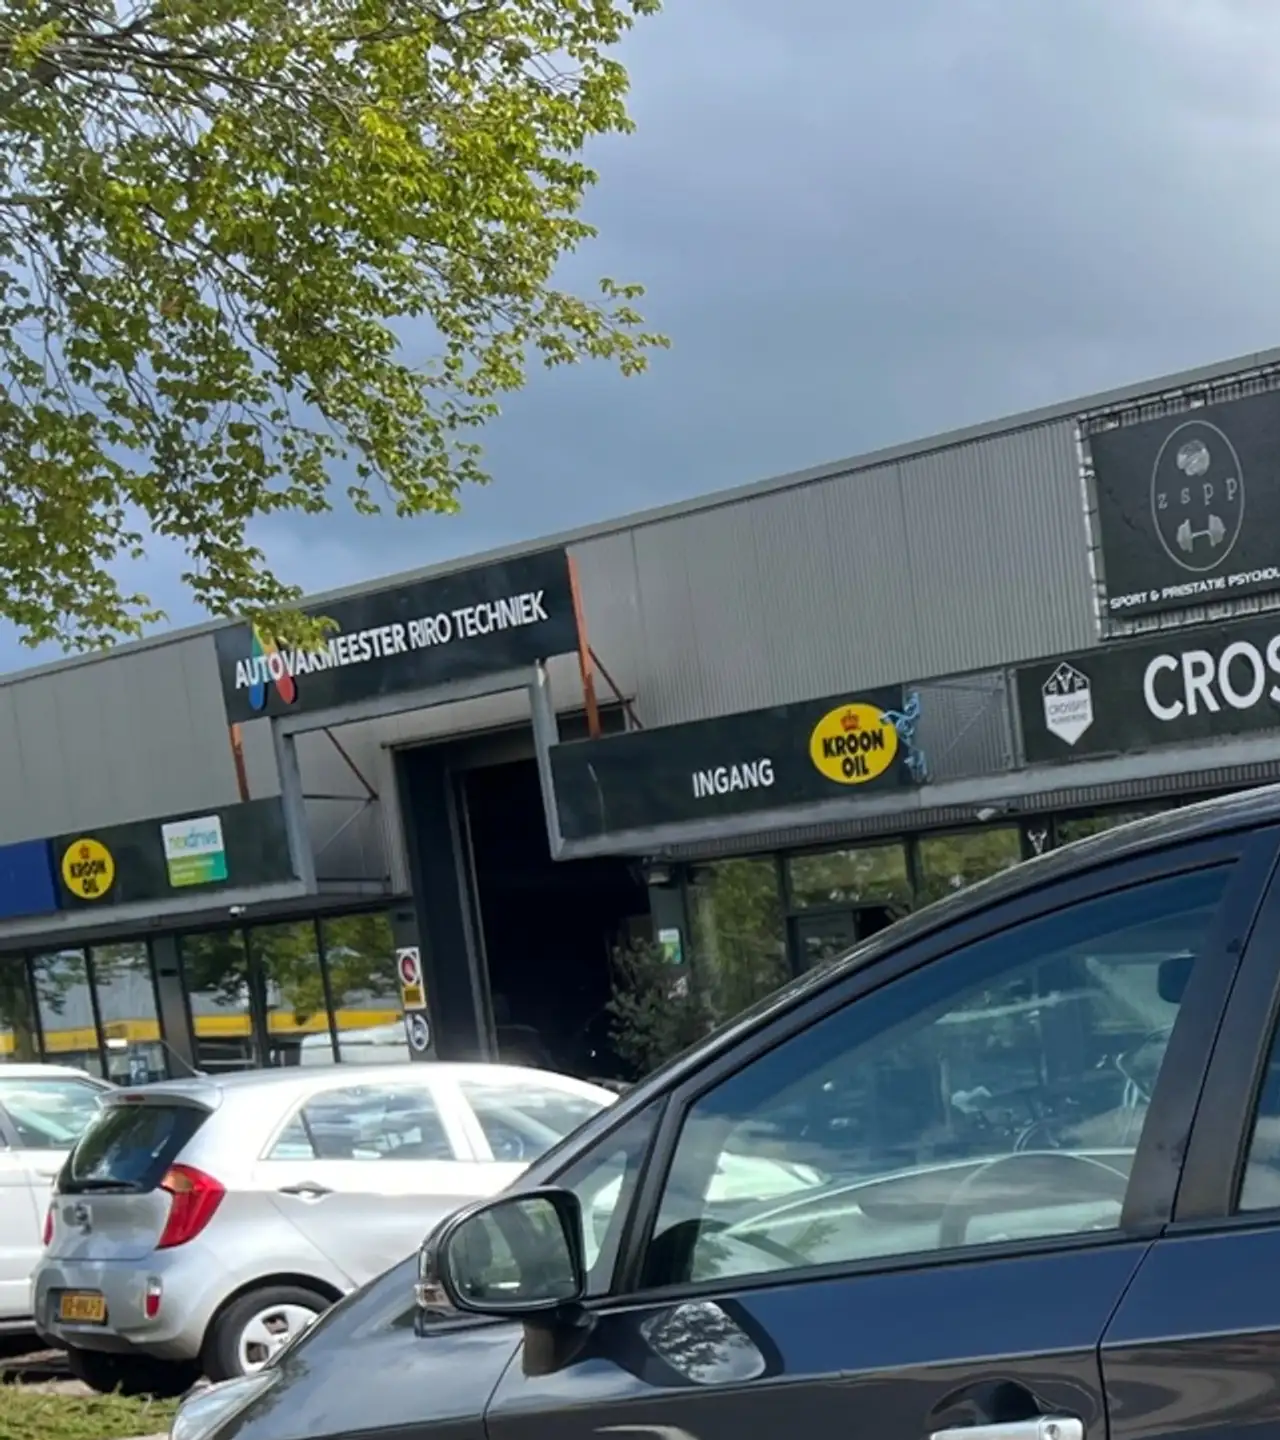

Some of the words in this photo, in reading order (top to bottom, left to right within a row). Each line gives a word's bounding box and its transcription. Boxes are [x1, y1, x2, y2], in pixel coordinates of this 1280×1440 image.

[1110, 592, 1148, 609] SPORT
[1150, 591, 1160, 602] &
[1162, 576, 1226, 599] PRESTATIE
[235, 623, 407, 689] AUTOVAKMEESTER
[408, 612, 452, 649] RIRO
[452, 590, 548, 639] TECHNIEK
[822, 729, 885, 758] KROON
[692, 758, 775, 798] INGANG
[841, 756, 869, 778] OIL
